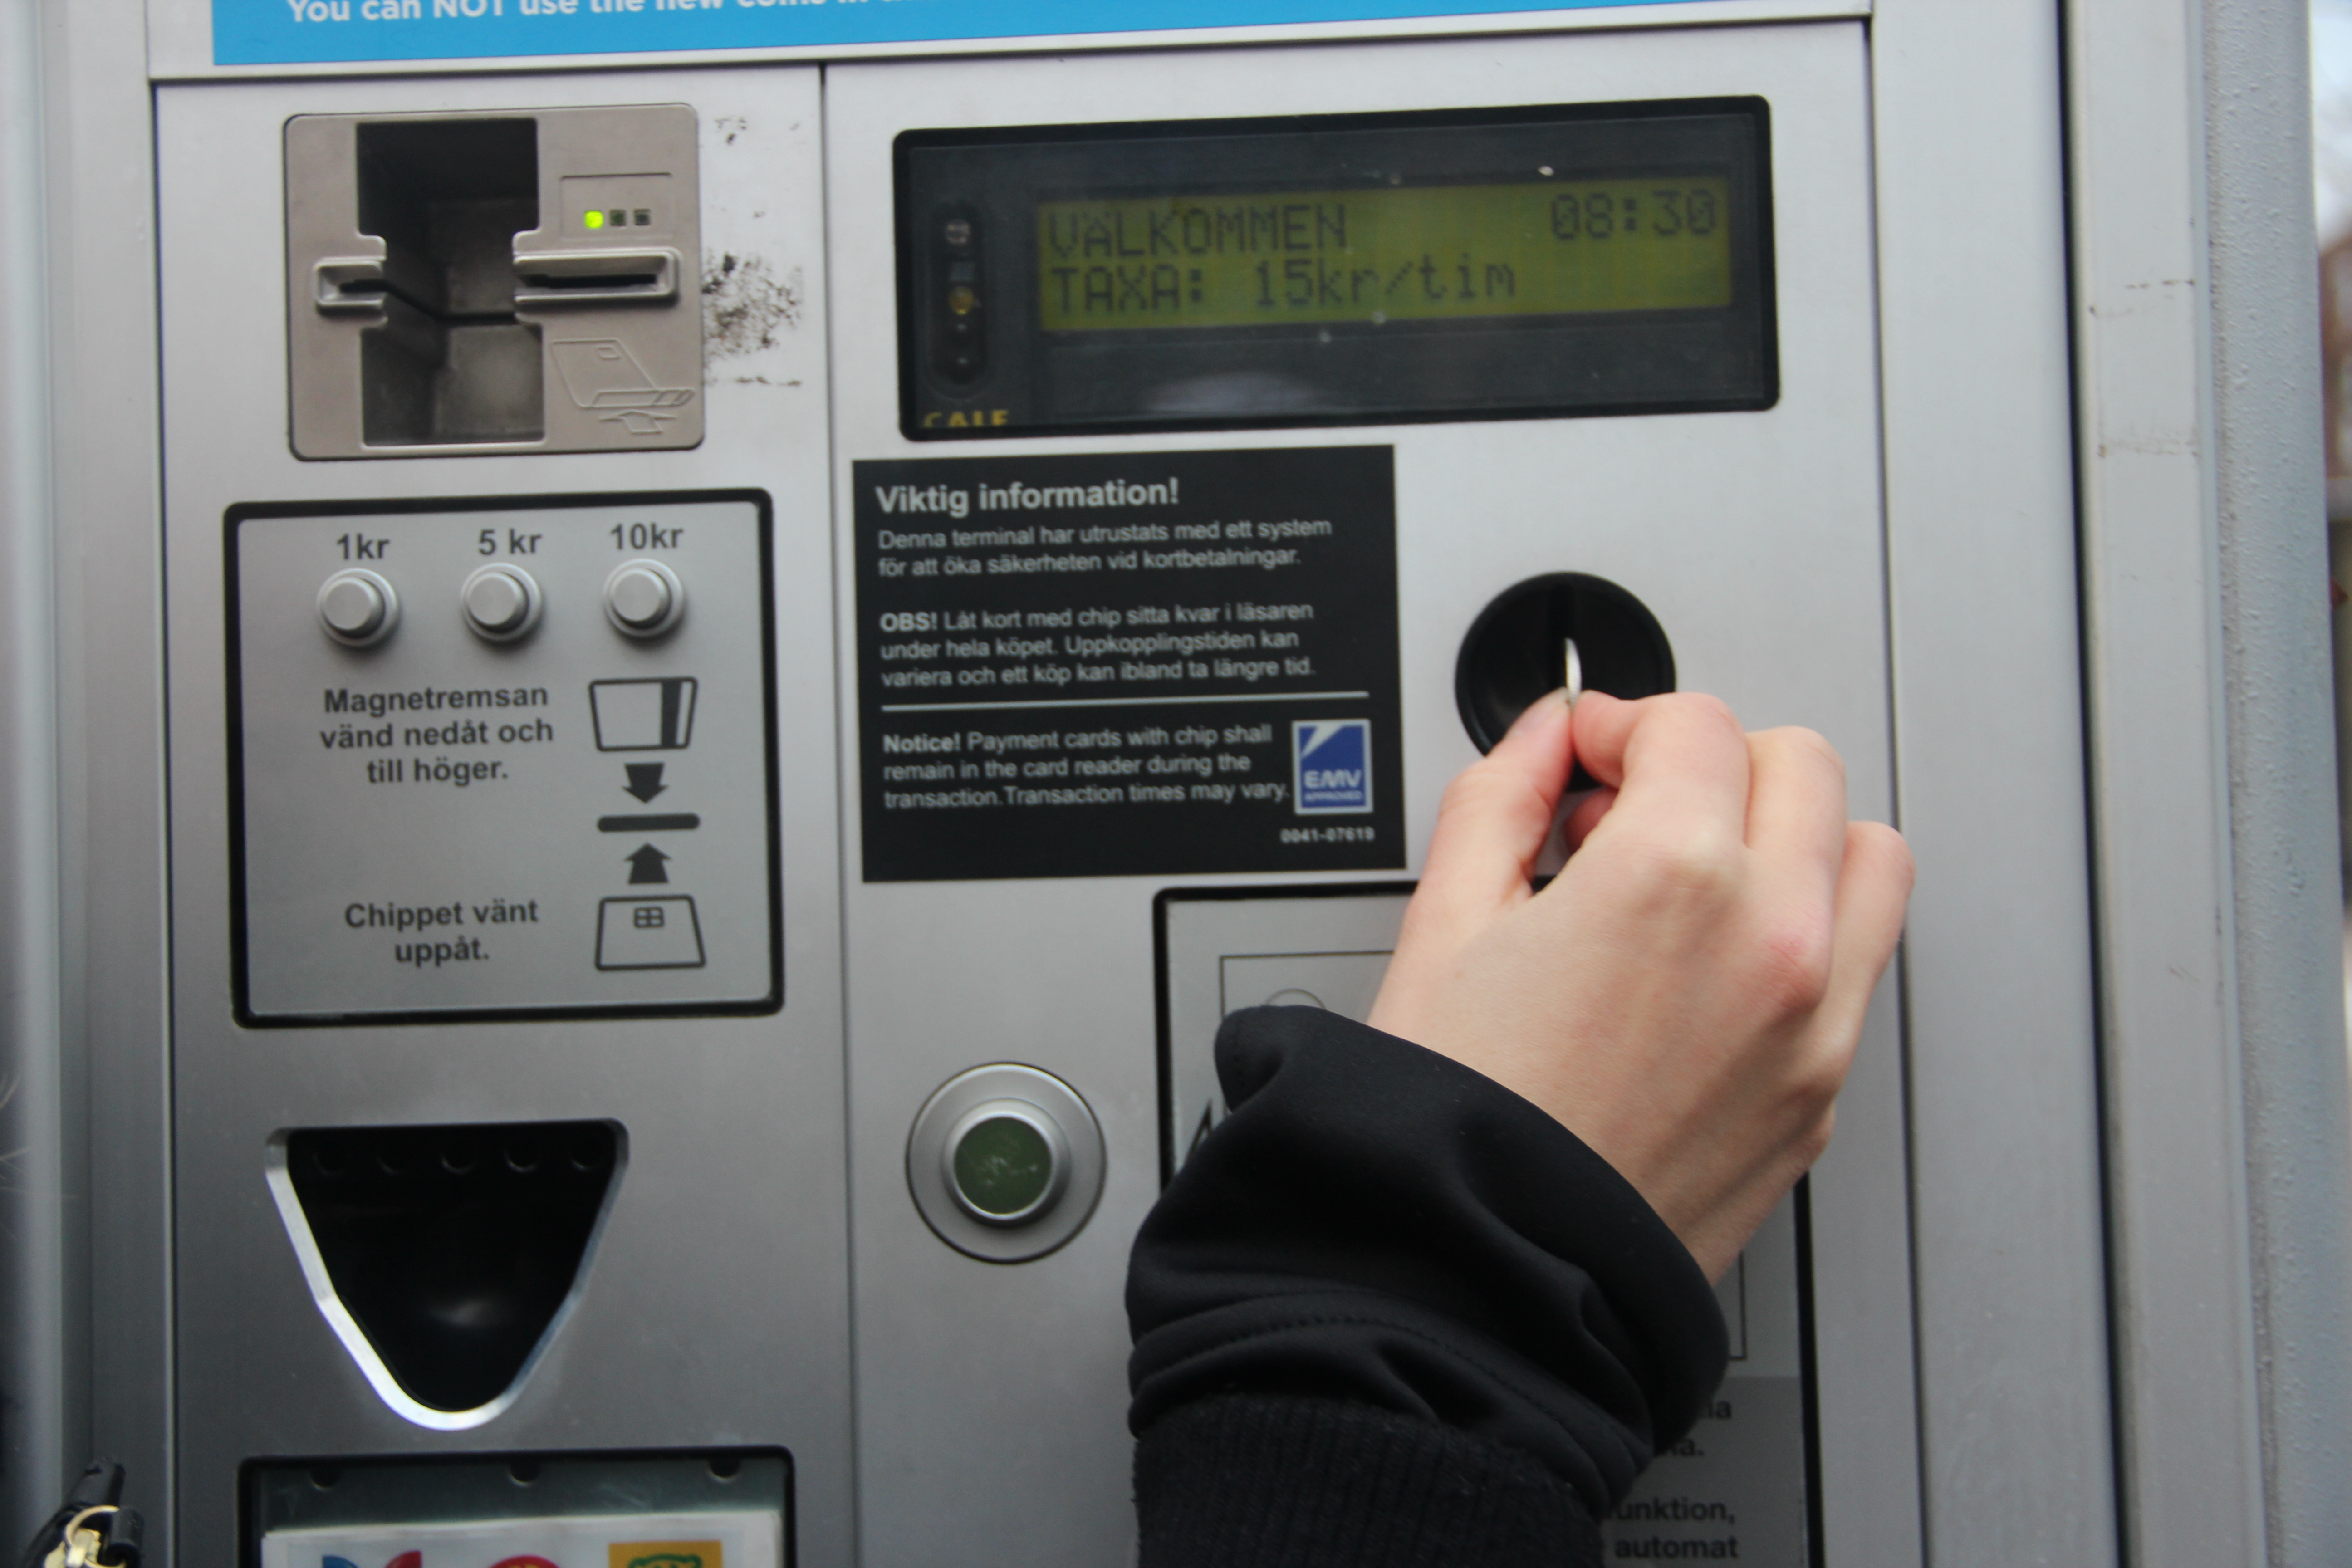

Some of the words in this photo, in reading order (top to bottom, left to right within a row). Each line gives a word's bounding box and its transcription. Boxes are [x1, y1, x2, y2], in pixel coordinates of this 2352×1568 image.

[288, 0, 350, 22] You
[362, 0, 421, 20] can
[1048, 203, 1346, 259] VÄLKOMMEN
[1551, 189, 1717, 240] 08:30
[1052, 263, 1204, 313] TAXA:
[1255, 251, 1515, 309] 15kr/tim
[876, 485, 968, 517] Viktig
[980, 477, 1177, 509] information!
[336, 533, 391, 561] 1kr
[478, 528, 497, 556] 5
[508, 527, 543, 555] kr
[609, 522, 684, 551] 10kr
[879, 530, 946, 549] Denna
[953, 529, 1033, 545] terminal
[1041, 528, 1073, 543] har
[1081, 525, 1168, 543] utrustats
[1175, 521, 1220, 539] med
[1226, 521, 1252, 538] ett
[1259, 519, 1332, 541] system
[878, 558, 906, 577] för
[912, 559, 938, 575] att
[944, 556, 981, 574] öka
[988, 554, 1101, 573] säkerheten
[1108, 552, 1137, 569] vid
[1143, 548, 1301, 570] kortbetalningar.
[880, 612, 937, 632] OBS!
[945, 611, 976, 630] Låt
[982, 611, 1021, 628] kort
[1028, 609, 1072, 626] med
[1078, 609, 1121, 628] chip
[1127, 607, 1169, 624] sitta
[1175, 606, 1219, 622] kvar
[1226, 604, 1231, 620] i
[1237, 602, 1313, 620] läsaren
[881, 641, 940, 659] under
[946, 639, 990, 657] hela
[996, 637, 1059, 657] köpet.
[1066, 632, 1254, 656] Uppkopplingstiden
[1261, 631, 1298, 648] kan
[882, 670, 952, 686] variera
[959, 668, 995, 684] och
[1002, 667, 1027, 683] ett
[1034, 666, 1071, 686] köp
[1078, 664, 1114, 681] kan
[1122, 662, 1182, 679] ibland
[1189, 661, 1208, 678] ta
[1215, 659, 1279, 681] längre
[1285, 657, 1315, 676] tid.
[324, 686, 549, 718] Magnetremsan
[320, 723, 393, 749] vänd
[405, 720, 488, 746] nedåt
[498, 718, 554, 743] och
[883, 732, 960, 752] Notice!
[968, 731, 1058, 754] Payment
[1065, 729, 1121, 748] cards
[1128, 728, 1168, 745] with
[1176, 727, 1217, 747] chip
[1224, 724, 1272, 743] shall
[367, 758, 404, 784] till
[414, 757, 509, 787] höger.
[884, 761, 954, 780] remain
[961, 761, 978, 778] in
[985, 760, 1017, 777] the
[1024, 758, 1068, 776] card
[1075, 756, 1140, 775] reader
[1148, 755, 1212, 777] during
[1218, 753, 1251, 771] the
[1303, 769, 1361, 789] EMV
[1129, 784, 1185, 801] times
[1191, 784, 1235, 803] may
[1241, 782, 1290, 803] vary.
[344, 901, 464, 932] Chippet
[472, 898, 539, 924] vänt
[395, 936, 490, 968] uppåt.
[1614, 1534, 1740, 1559] automat
